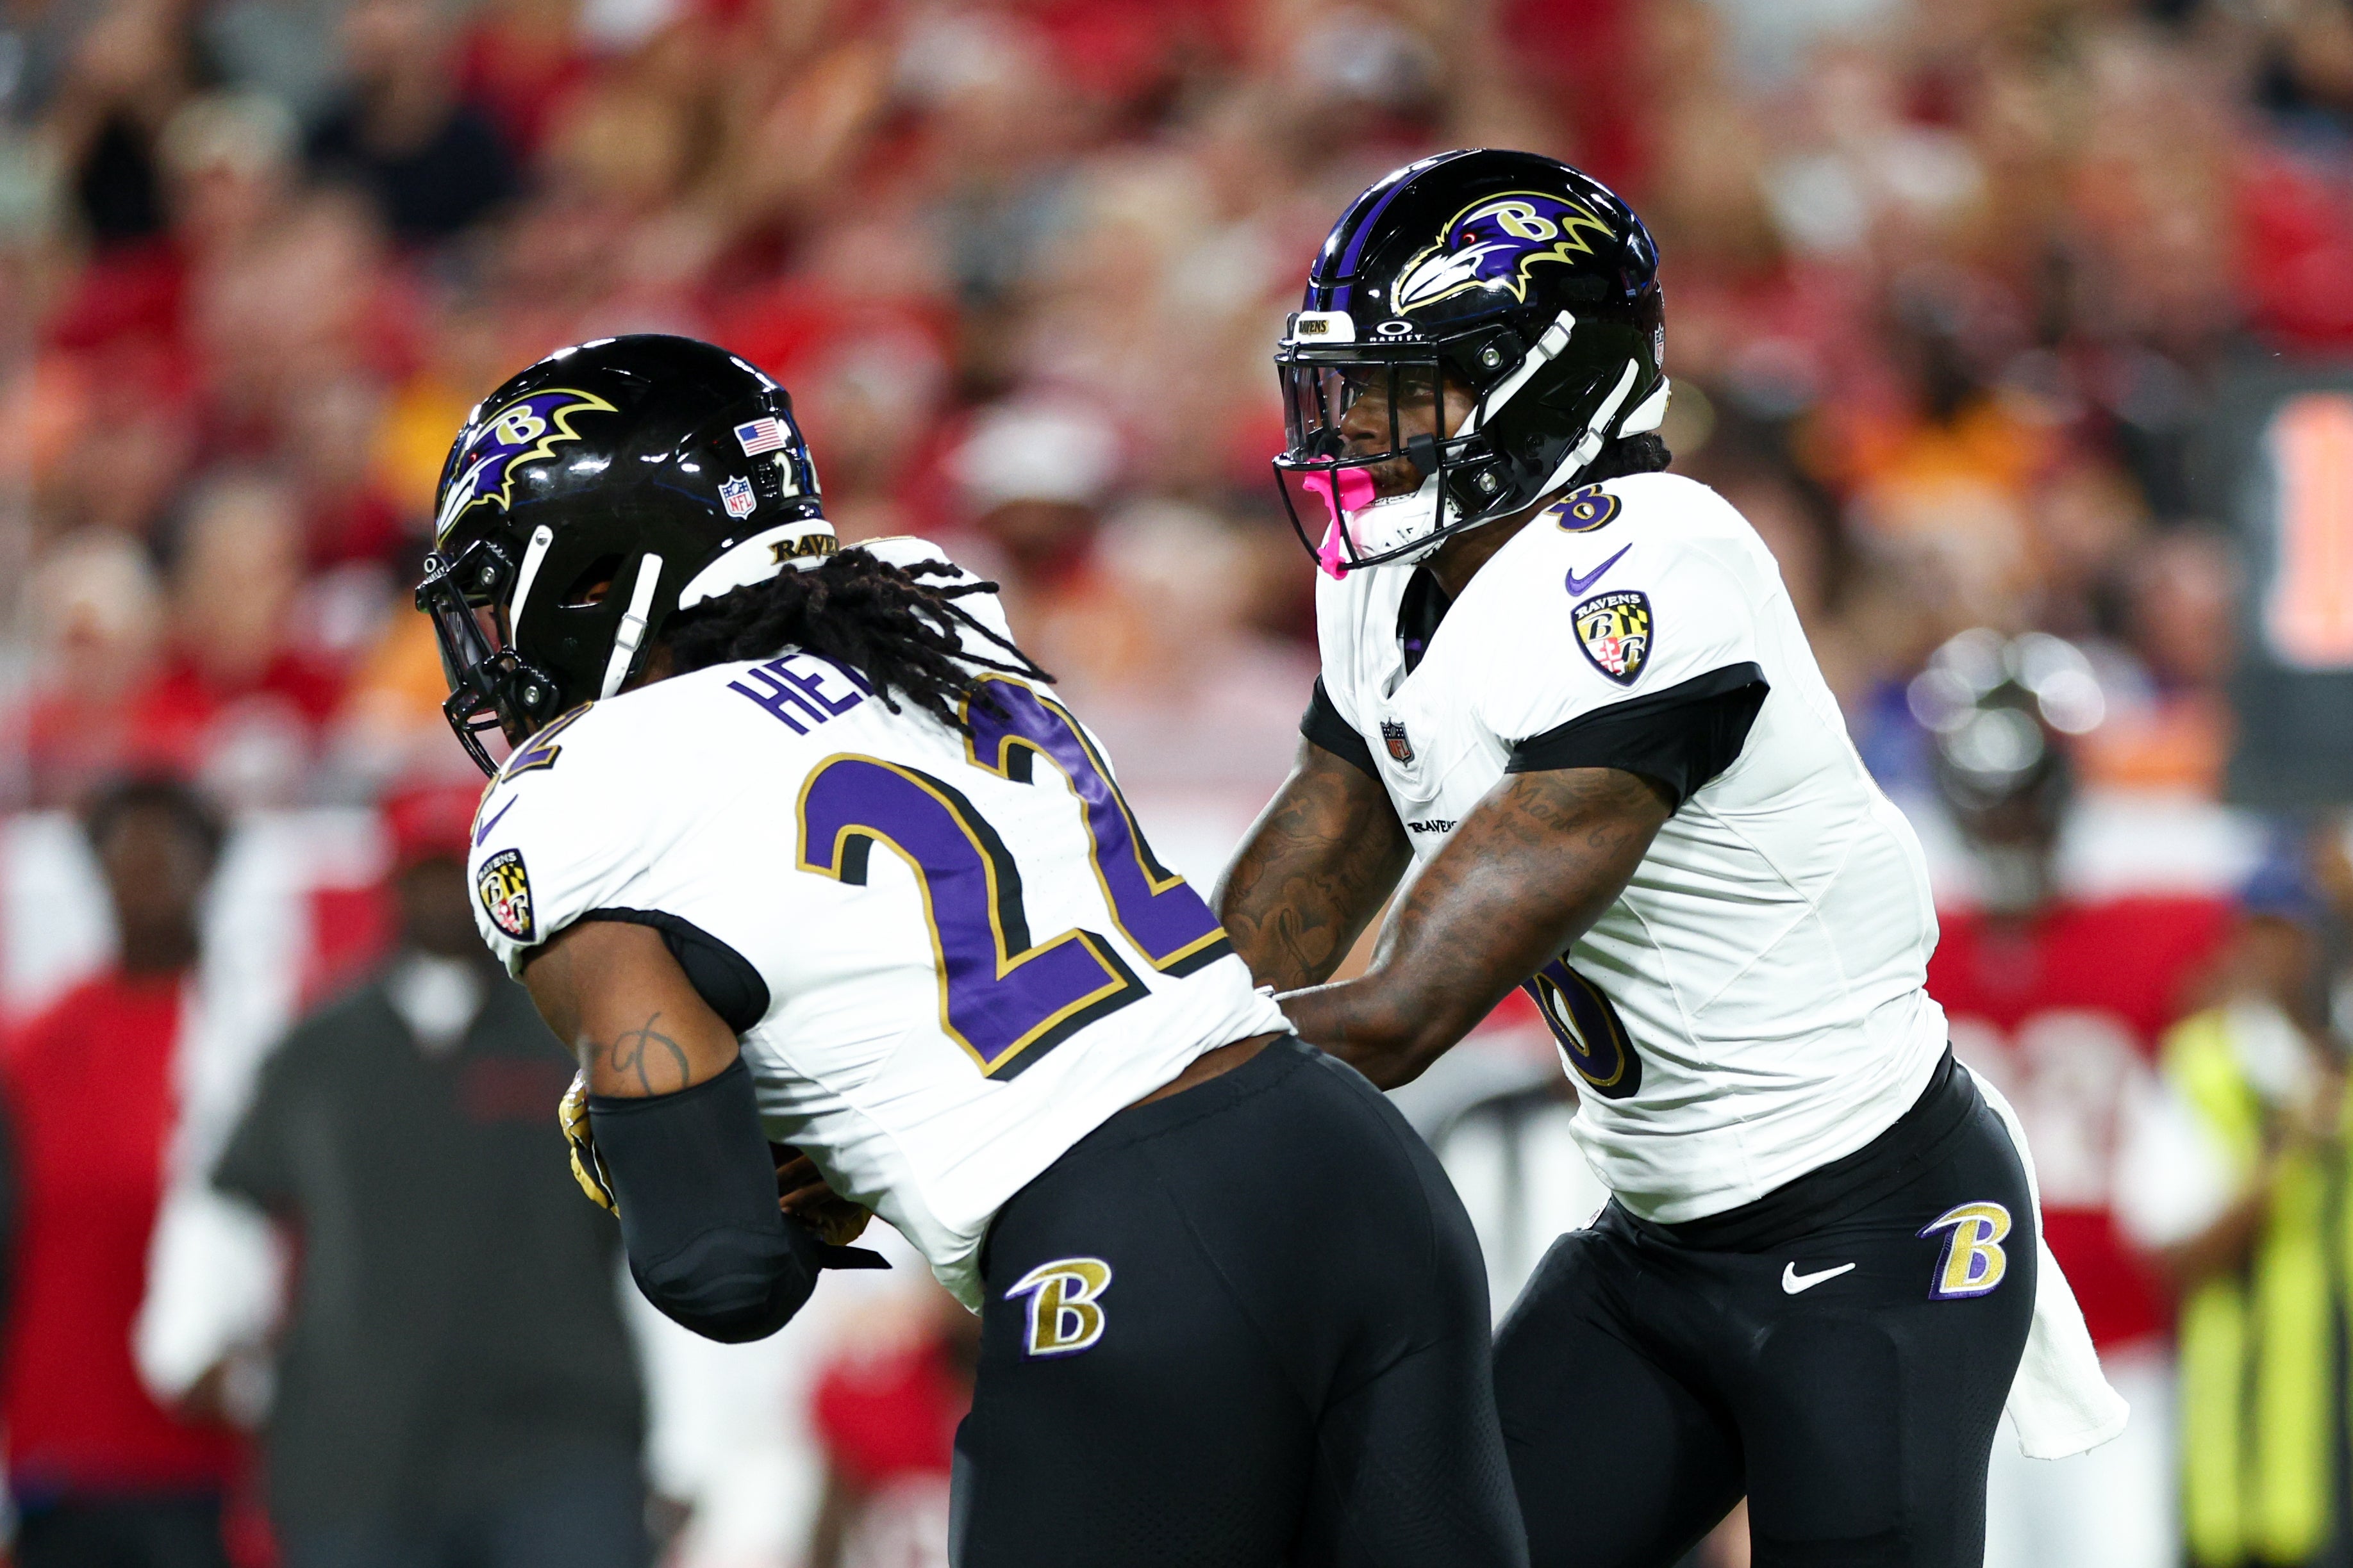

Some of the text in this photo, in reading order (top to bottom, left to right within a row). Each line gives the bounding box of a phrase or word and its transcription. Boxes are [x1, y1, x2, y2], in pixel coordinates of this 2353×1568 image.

[1463, 201, 1558, 242] B
[476, 405, 546, 446] B
[728, 493, 752, 512] NFL
[1542, 484, 1622, 533] 8
[1575, 594, 1642, 619] RAVENS
[1387, 739, 1411, 759] NFL
[794, 672, 1236, 1082] 22
[1915, 1200, 2013, 1301] B
[1002, 1254, 1114, 1362] B
